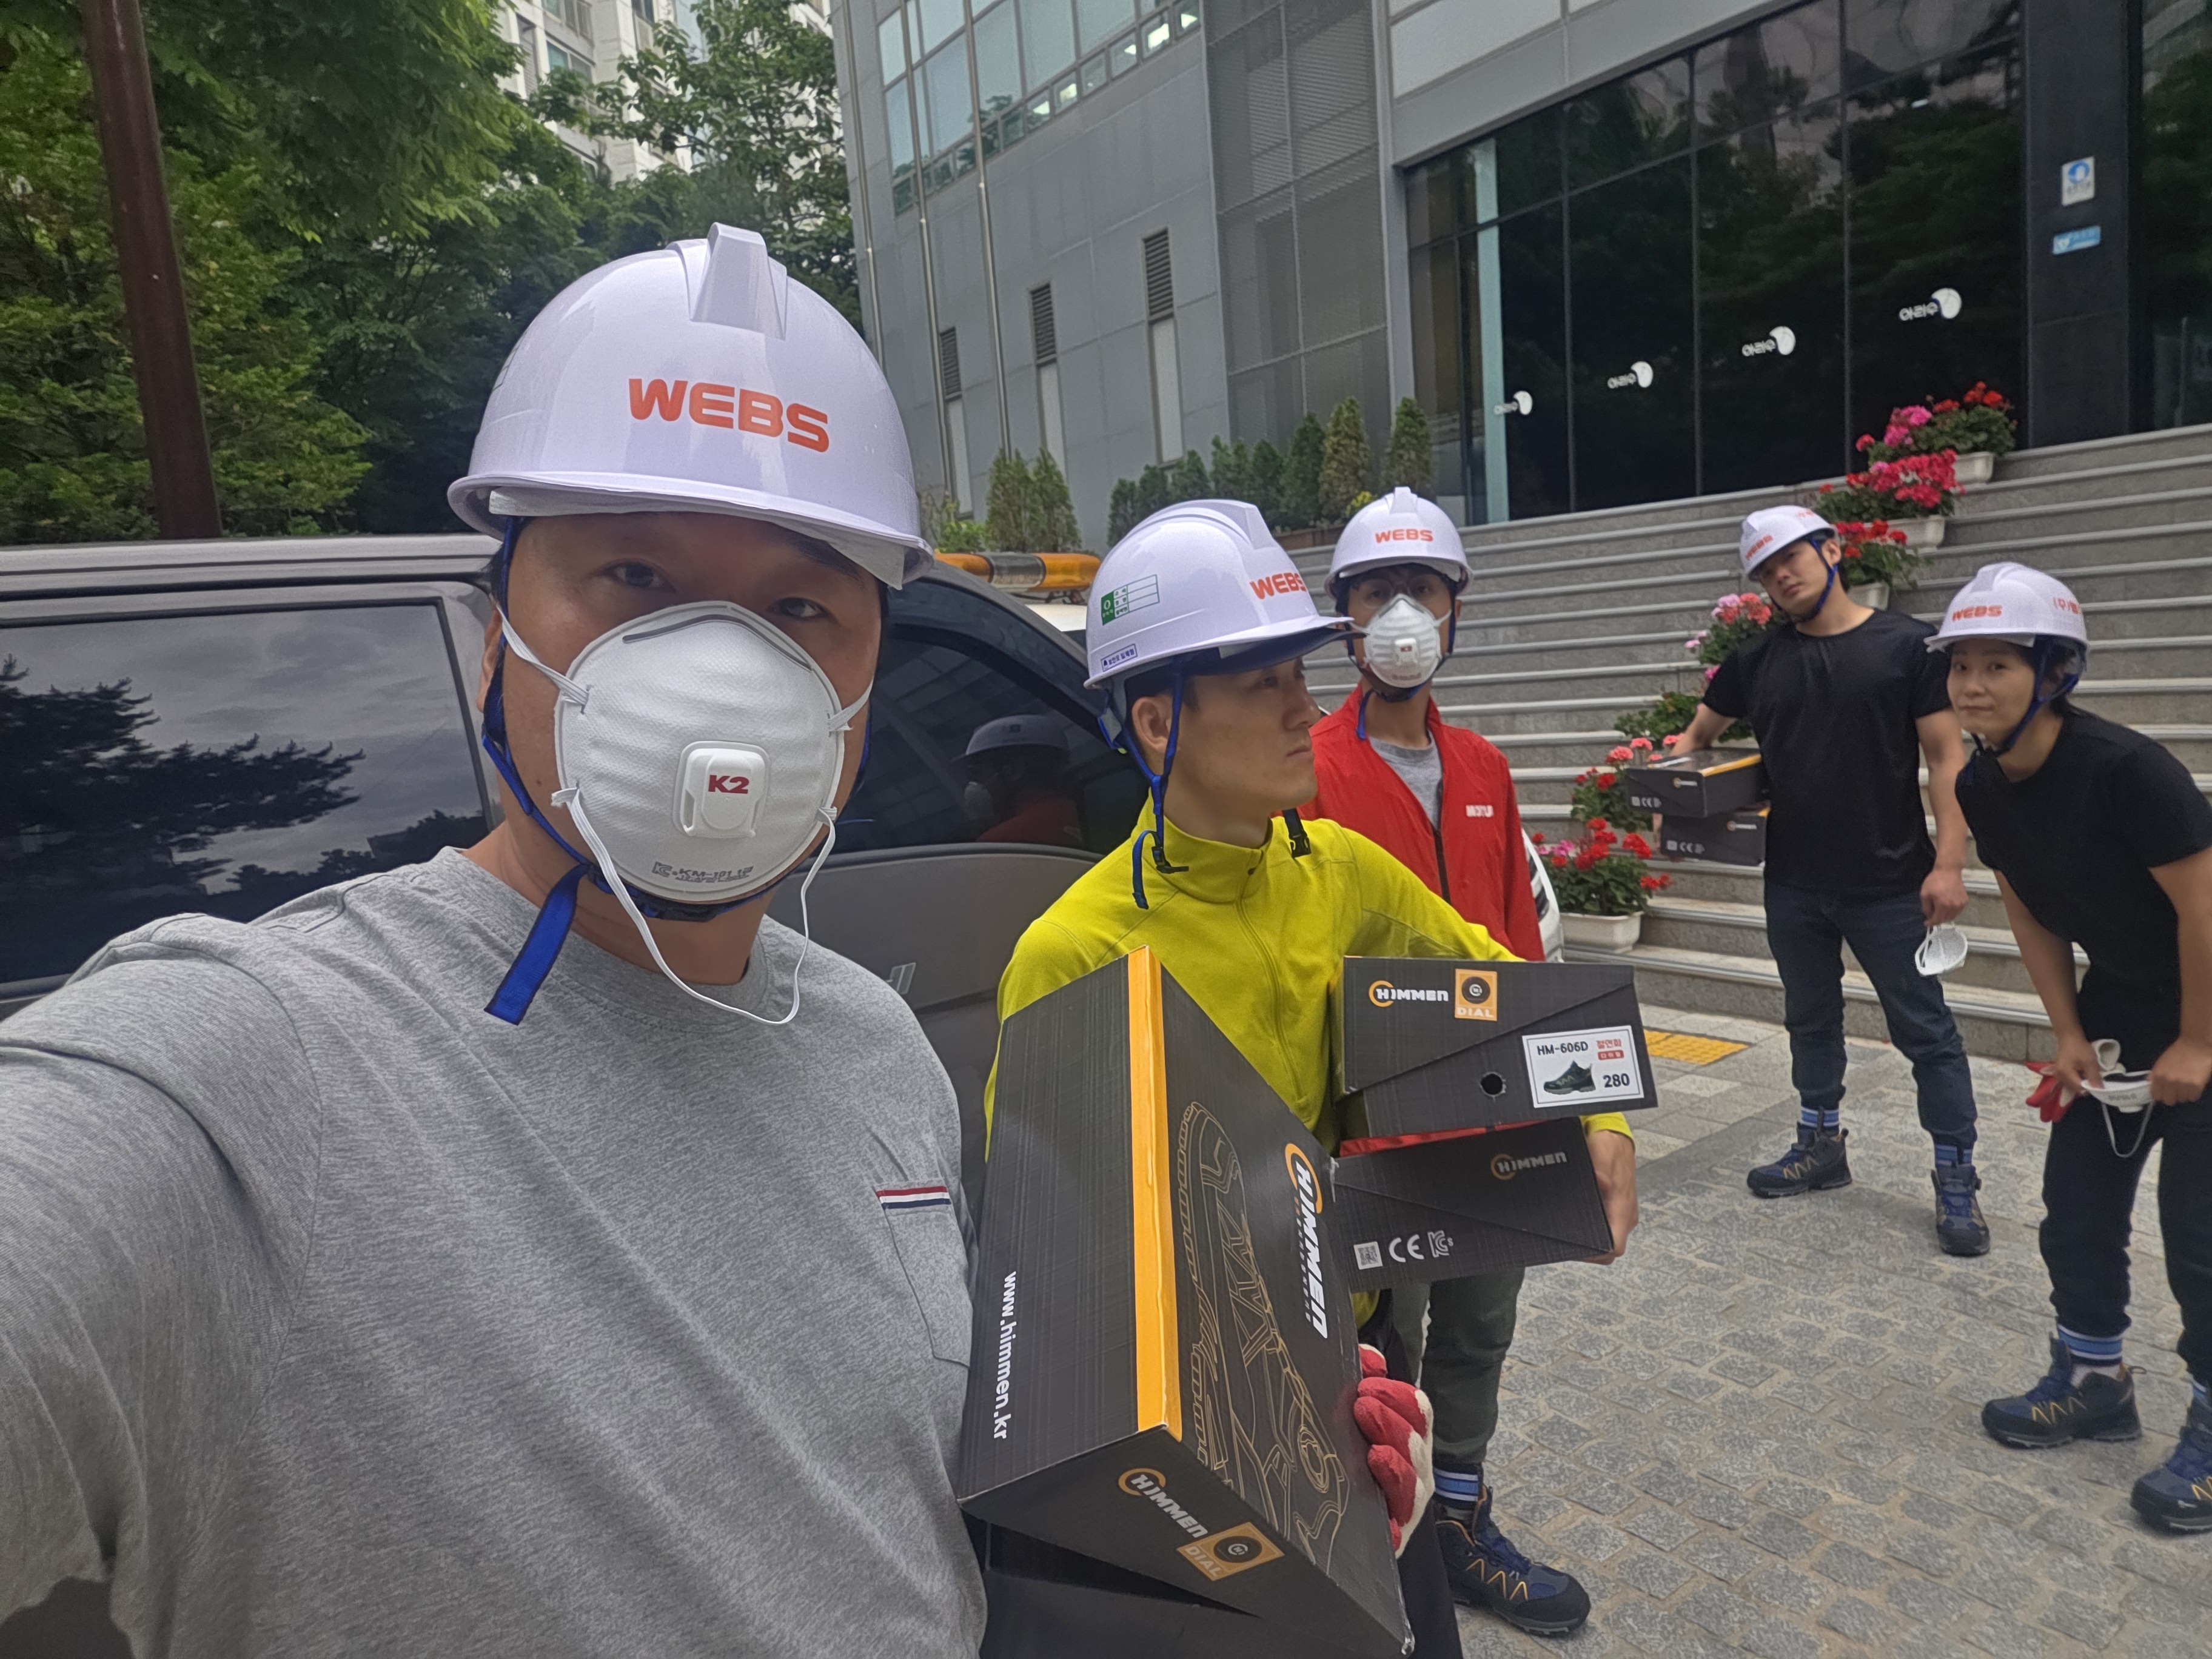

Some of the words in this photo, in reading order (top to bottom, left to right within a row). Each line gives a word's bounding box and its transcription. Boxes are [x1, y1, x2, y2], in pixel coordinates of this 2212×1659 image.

[629, 378, 829, 452] WEBS
[1376, 529, 1433, 543] WEBS
[1952, 605, 2002, 622] WEBS
[708, 774, 749, 794] K2
[1376, 988, 1449, 1002] HIMMEN
[1457, 1007, 1495, 1018] DIAL
[1537, 1041, 1589, 1056] HM-606D
[1603, 1073, 1630, 1088] 280
[1496, 1151, 1567, 1173] HIMMEN
[1296, 1160, 1328, 1339] HIMMEN
[993, 1271, 1017, 1439] www.himmen.kr
[1130, 1473, 1208, 1539] HIMMEN
[1184, 1544, 1223, 1578] DIAL
